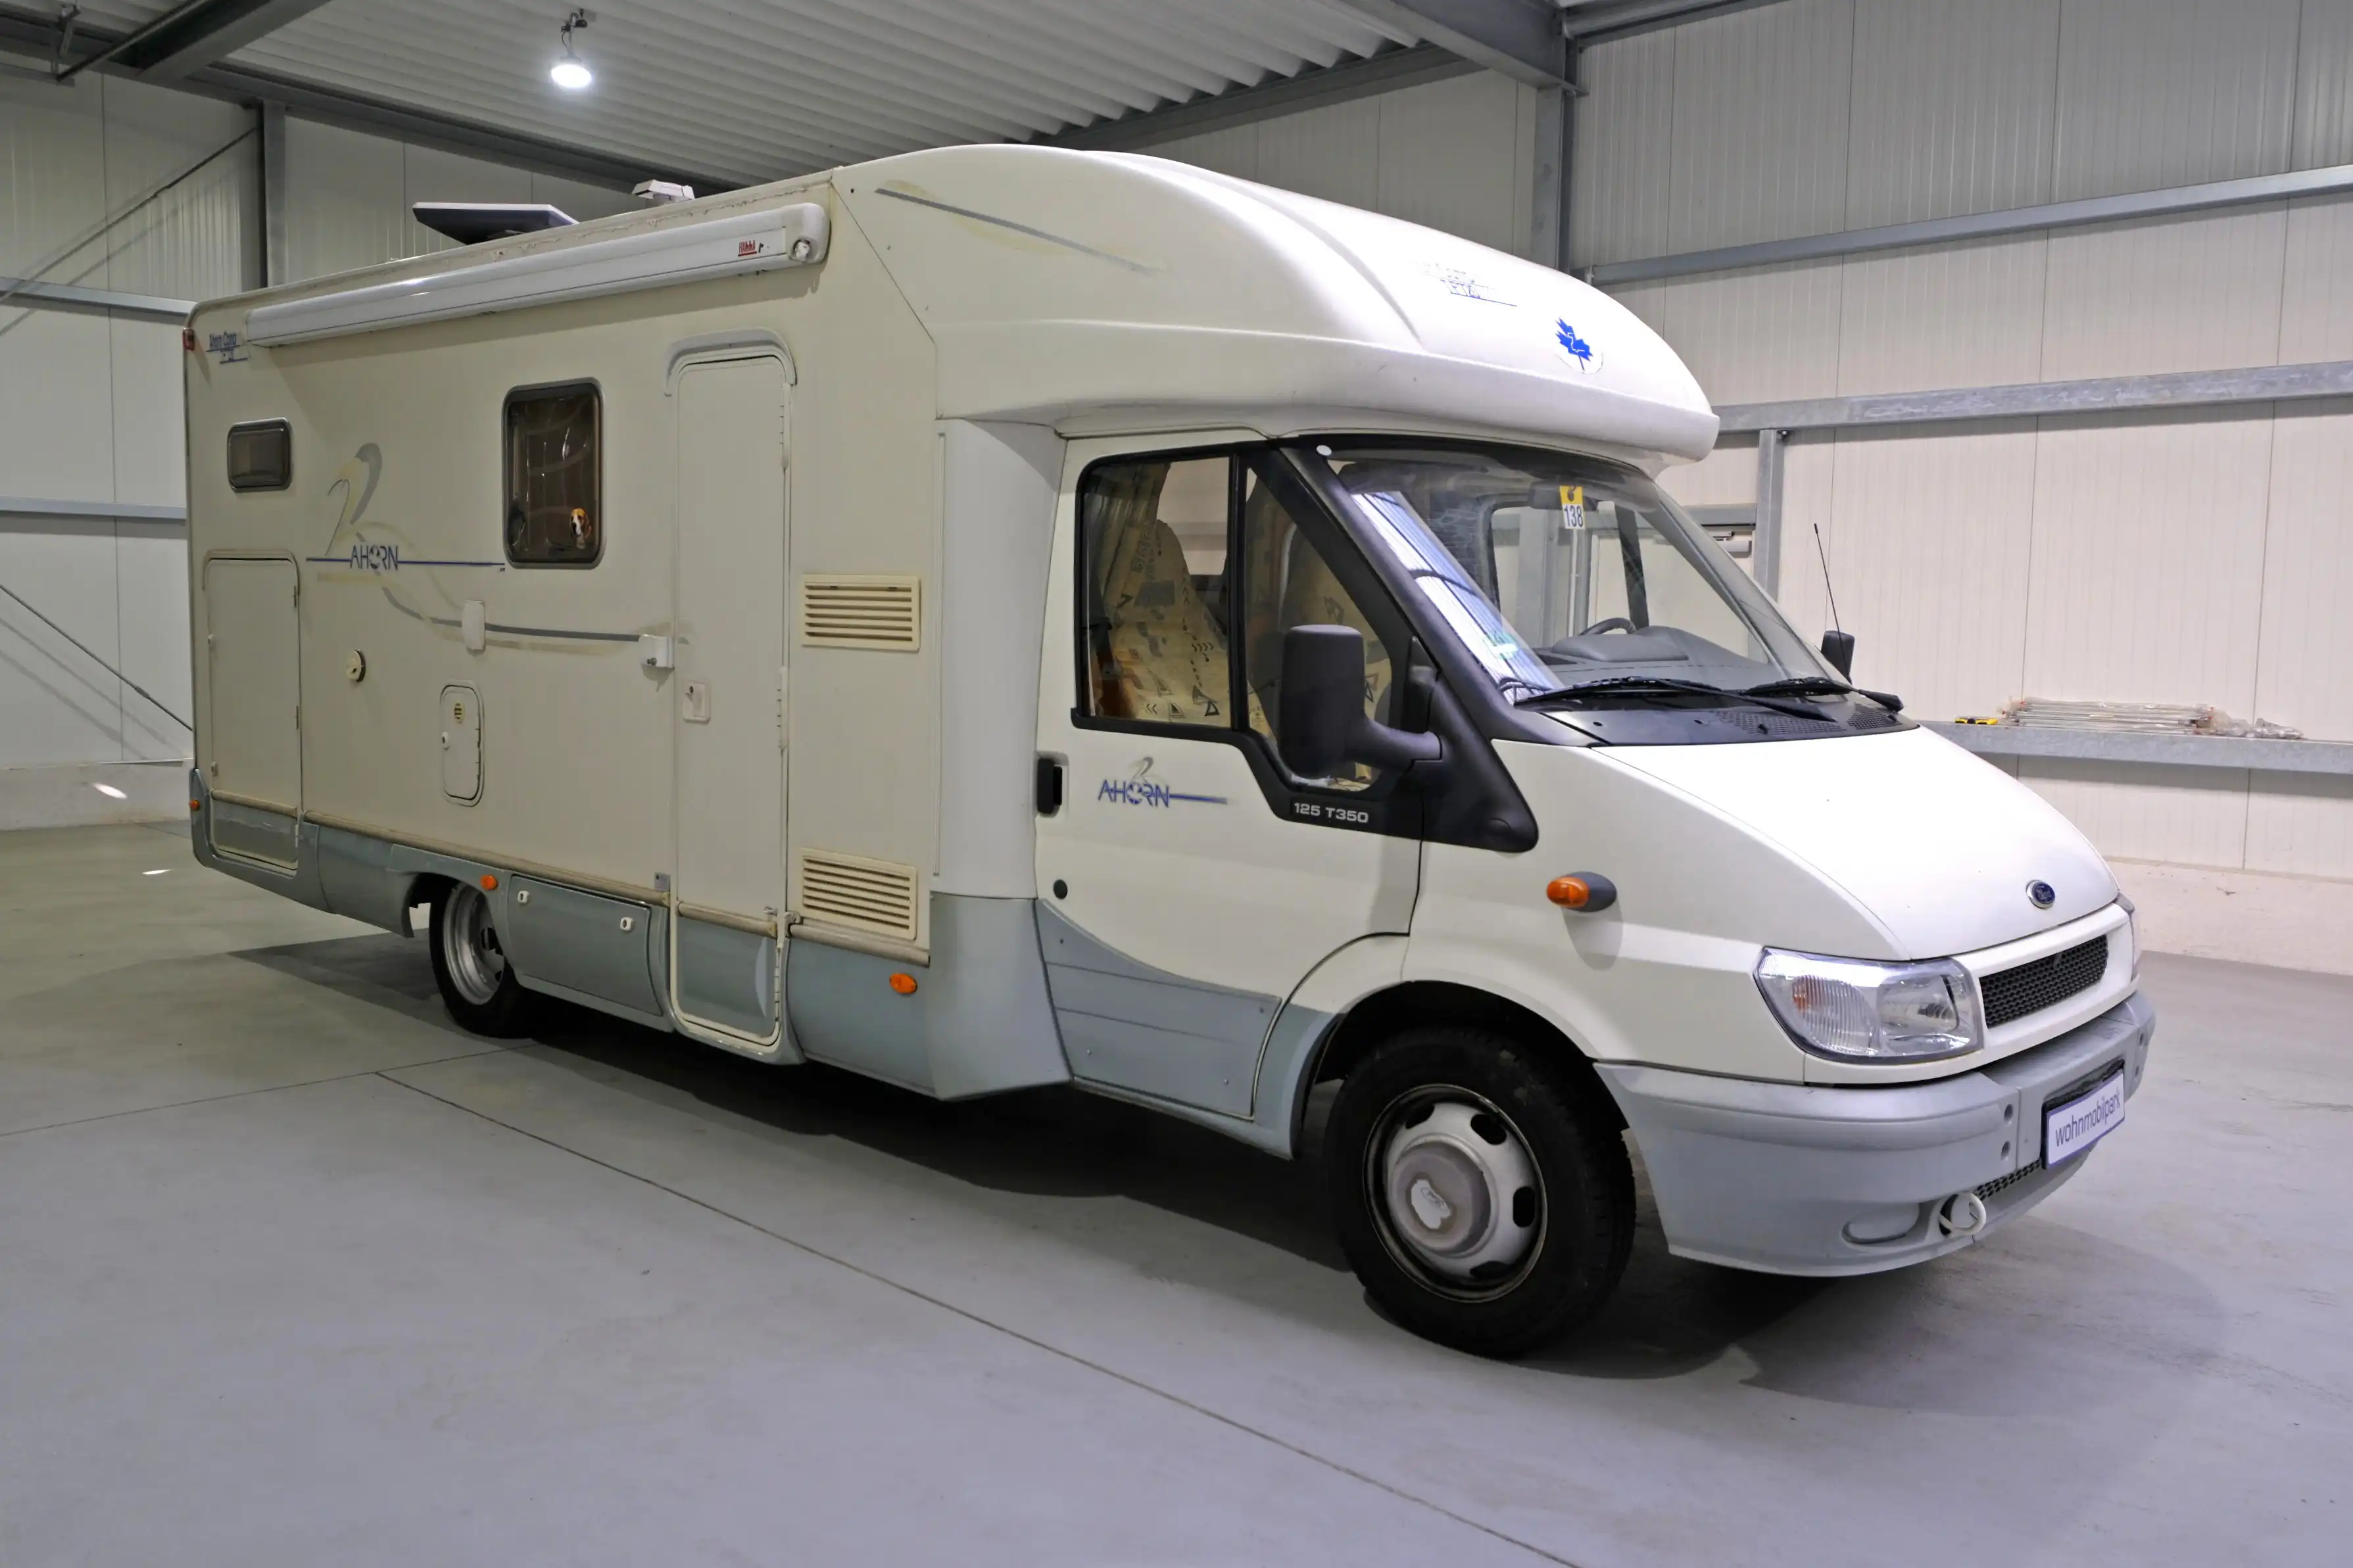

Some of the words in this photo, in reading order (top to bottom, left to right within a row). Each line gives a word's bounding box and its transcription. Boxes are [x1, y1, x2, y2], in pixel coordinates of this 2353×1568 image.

[1565, 504, 1584, 527] 138
[349, 545, 399, 571] AHORN
[1098, 779, 1169, 808] AHORN
[1294, 802, 1321, 817] 125
[1325, 807, 1369, 823] T350
[2055, 1085, 2121, 1147] wohnmobilpark
